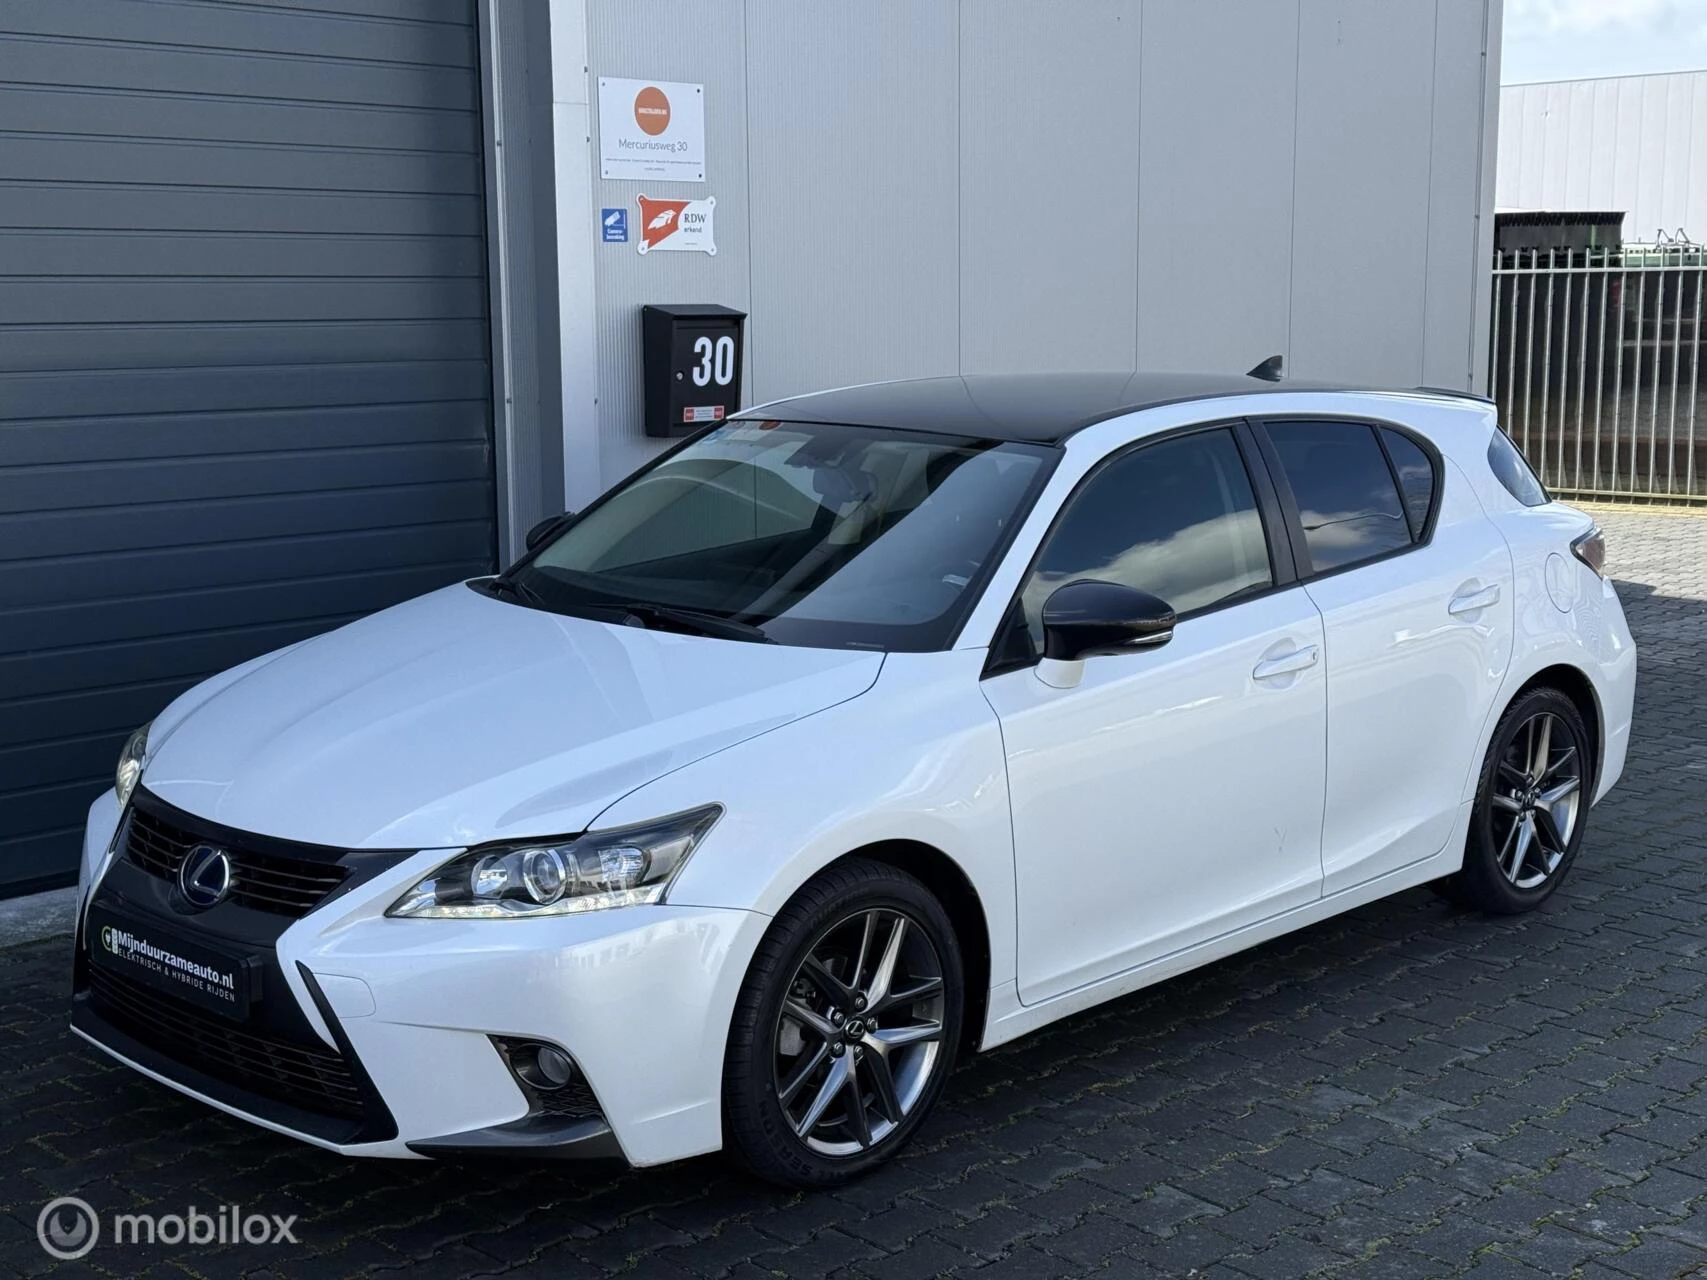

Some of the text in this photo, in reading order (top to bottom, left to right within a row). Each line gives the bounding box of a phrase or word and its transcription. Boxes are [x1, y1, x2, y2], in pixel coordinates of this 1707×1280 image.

[618, 138, 688, 153] Mercuriusweg 30
[684, 213, 707, 224] RDW
[692, 336, 735, 387] 30
[118, 930, 235, 990] Mijnduurzameauto.nl
[118, 948, 236, 1003] ELEKTRISCH & HYBRIDE RIJDEN
